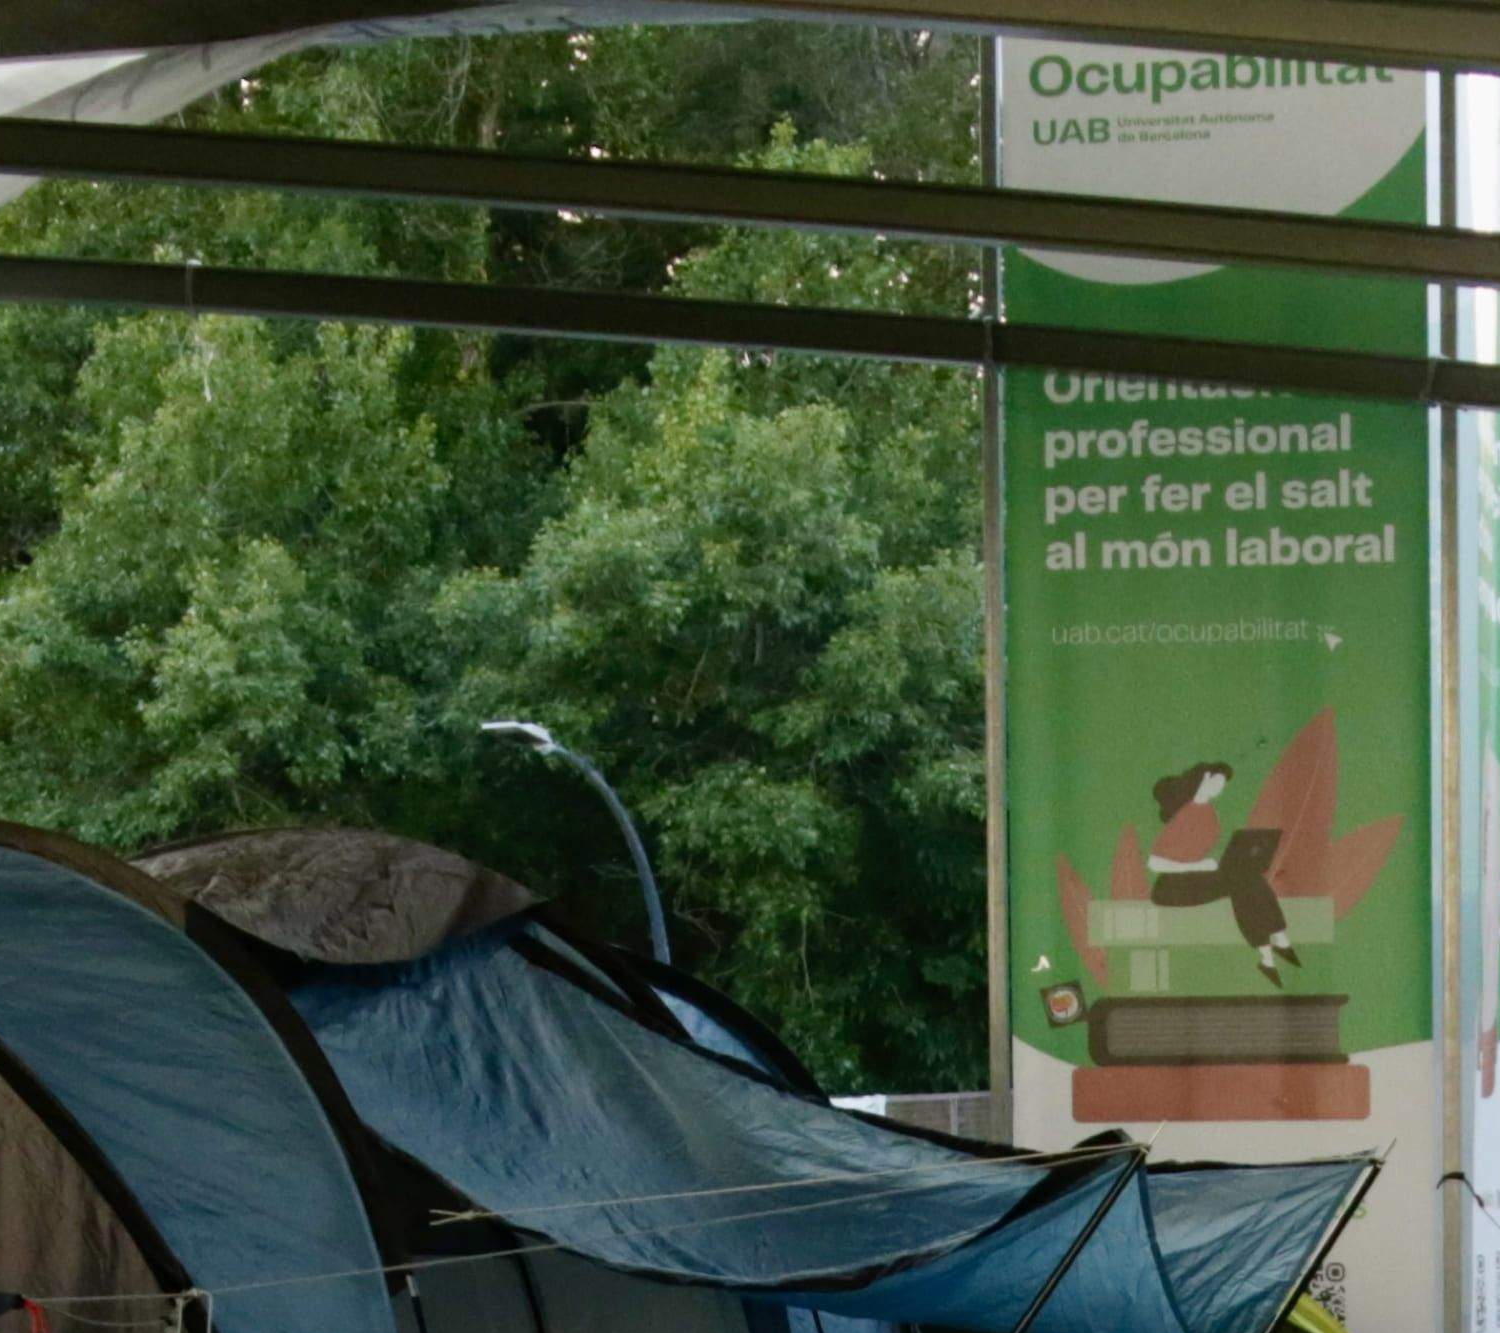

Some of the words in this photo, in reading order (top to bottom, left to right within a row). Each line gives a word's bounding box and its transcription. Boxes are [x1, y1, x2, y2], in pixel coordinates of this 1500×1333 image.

[1032, 117, 1111, 147] UAB
[1116, 115, 1195, 128] Universitat
[1117, 131, 1135, 144] de
[1139, 129, 1211, 143] Barcelona
[1044, 368, 1294, 404] Orienta
[1044, 411, 1351, 469] professional
[1044, 482, 1128, 525] per
[1141, 473, 1211, 513] fer
[1224, 470, 1267, 511] el
[1280, 467, 1374, 508] salt
[1045, 530, 1087, 570] al
[1101, 530, 1211, 570] món
[1225, 523, 1396, 567] laboral
[1051, 617, 1308, 646] uab.cat/ocupabilitat
